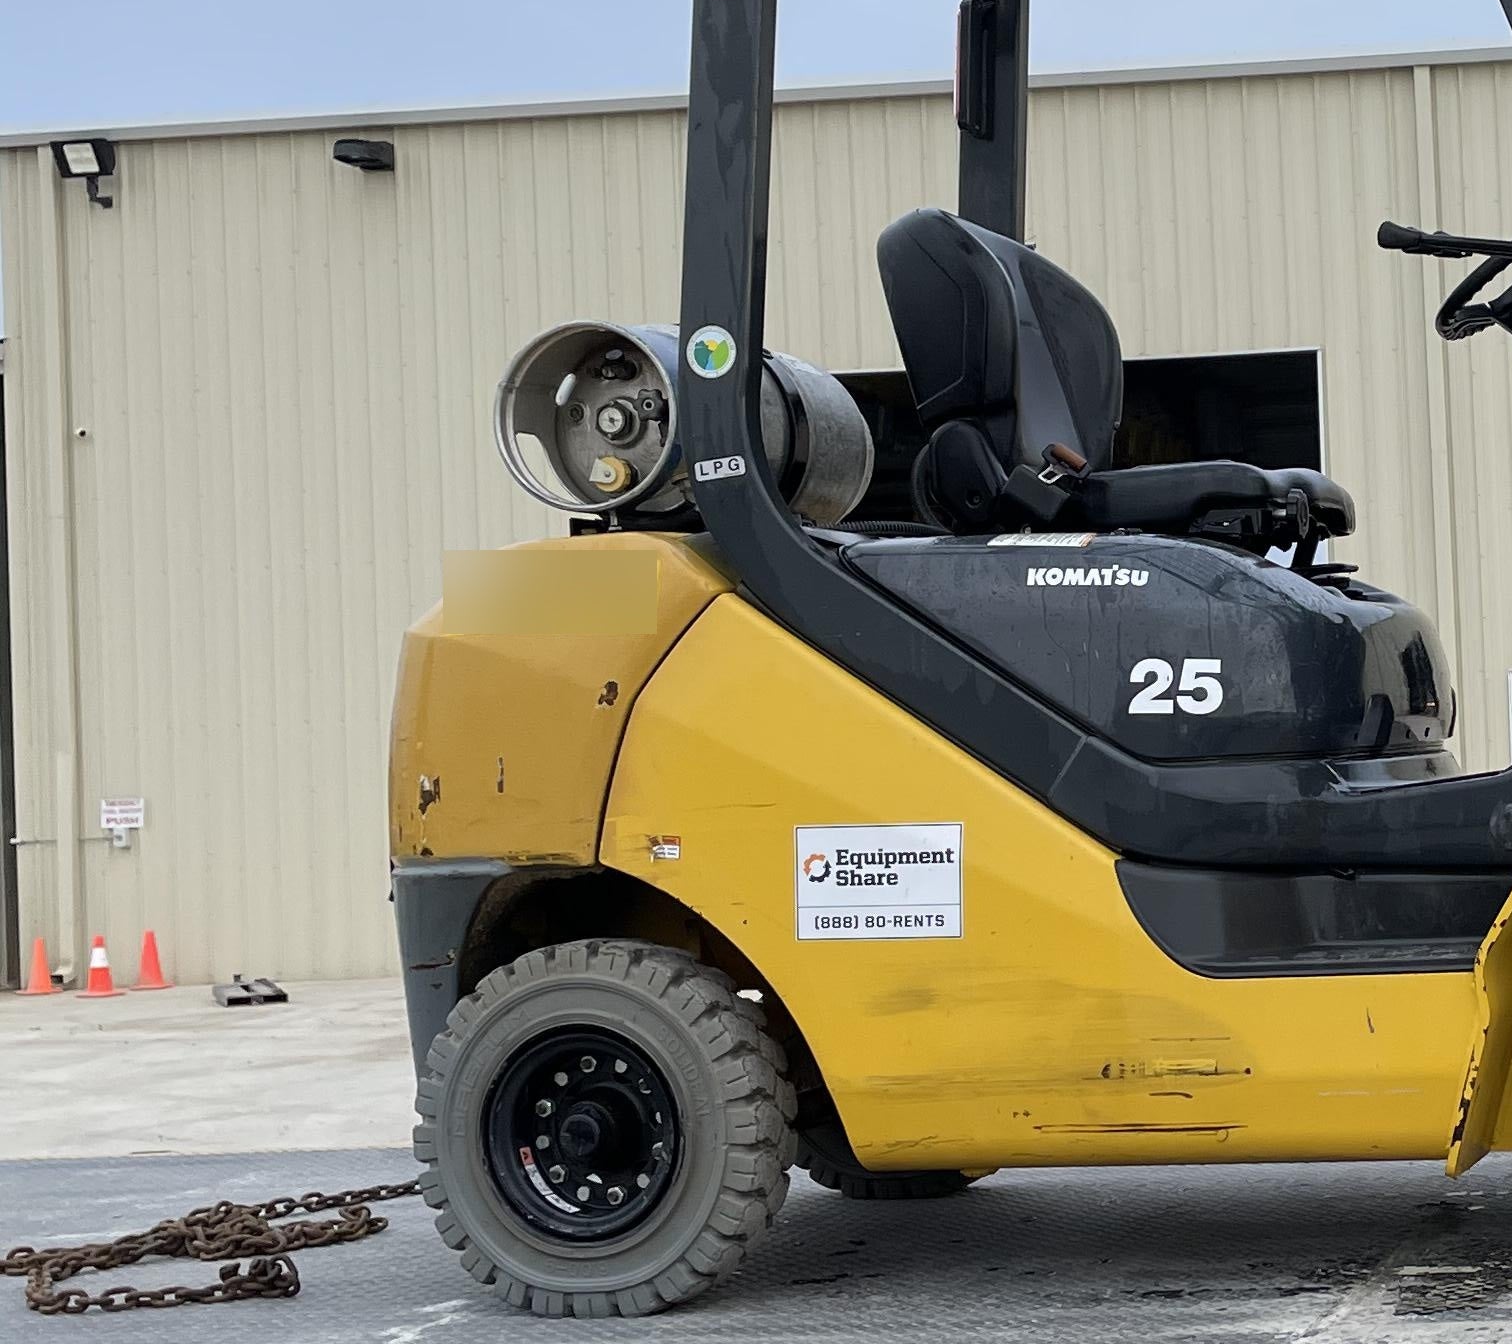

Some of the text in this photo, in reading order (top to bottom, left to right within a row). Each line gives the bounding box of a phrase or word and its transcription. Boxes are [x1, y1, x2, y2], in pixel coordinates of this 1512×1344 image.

[700, 458, 740, 476] LPG
[1026, 564, 1149, 586] KOMATSU
[1128, 658, 1223, 715] 25
[835, 848, 954, 868] Equipment
[835, 870, 898, 886] Share
[814, 914, 945, 930] (888) 80-RENTS
